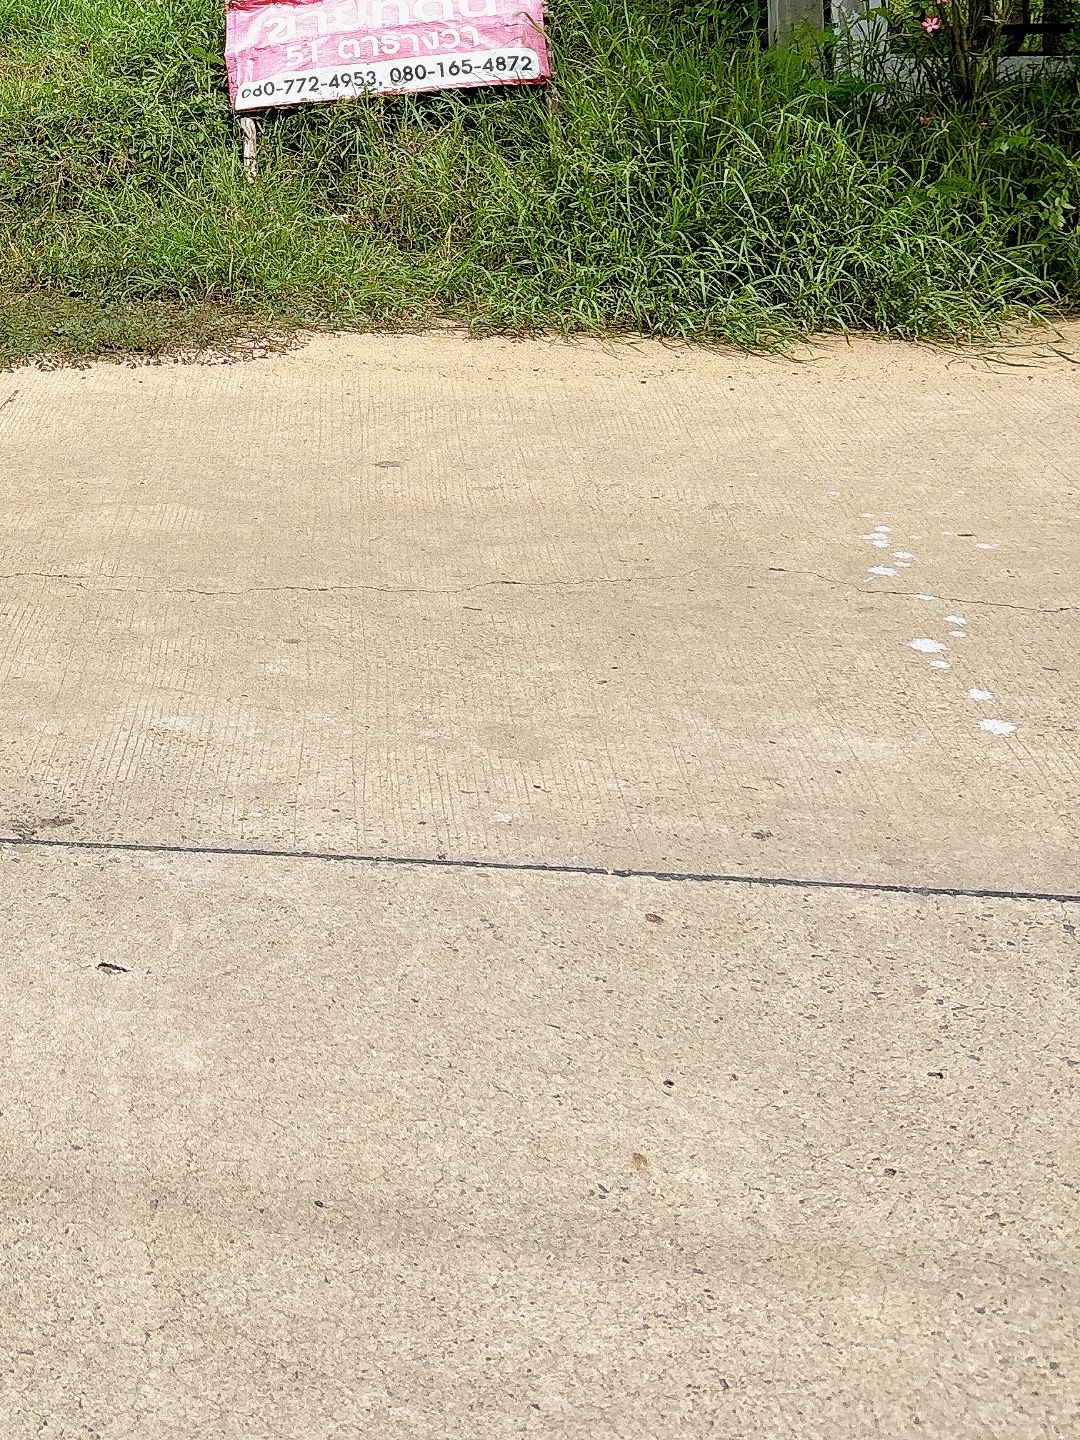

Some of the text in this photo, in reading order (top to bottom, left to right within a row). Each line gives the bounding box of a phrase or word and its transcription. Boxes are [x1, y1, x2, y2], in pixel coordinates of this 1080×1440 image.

[286, 26, 481, 67] 51 ตารางวา
[389, 56, 532, 83] 080-165-4872
